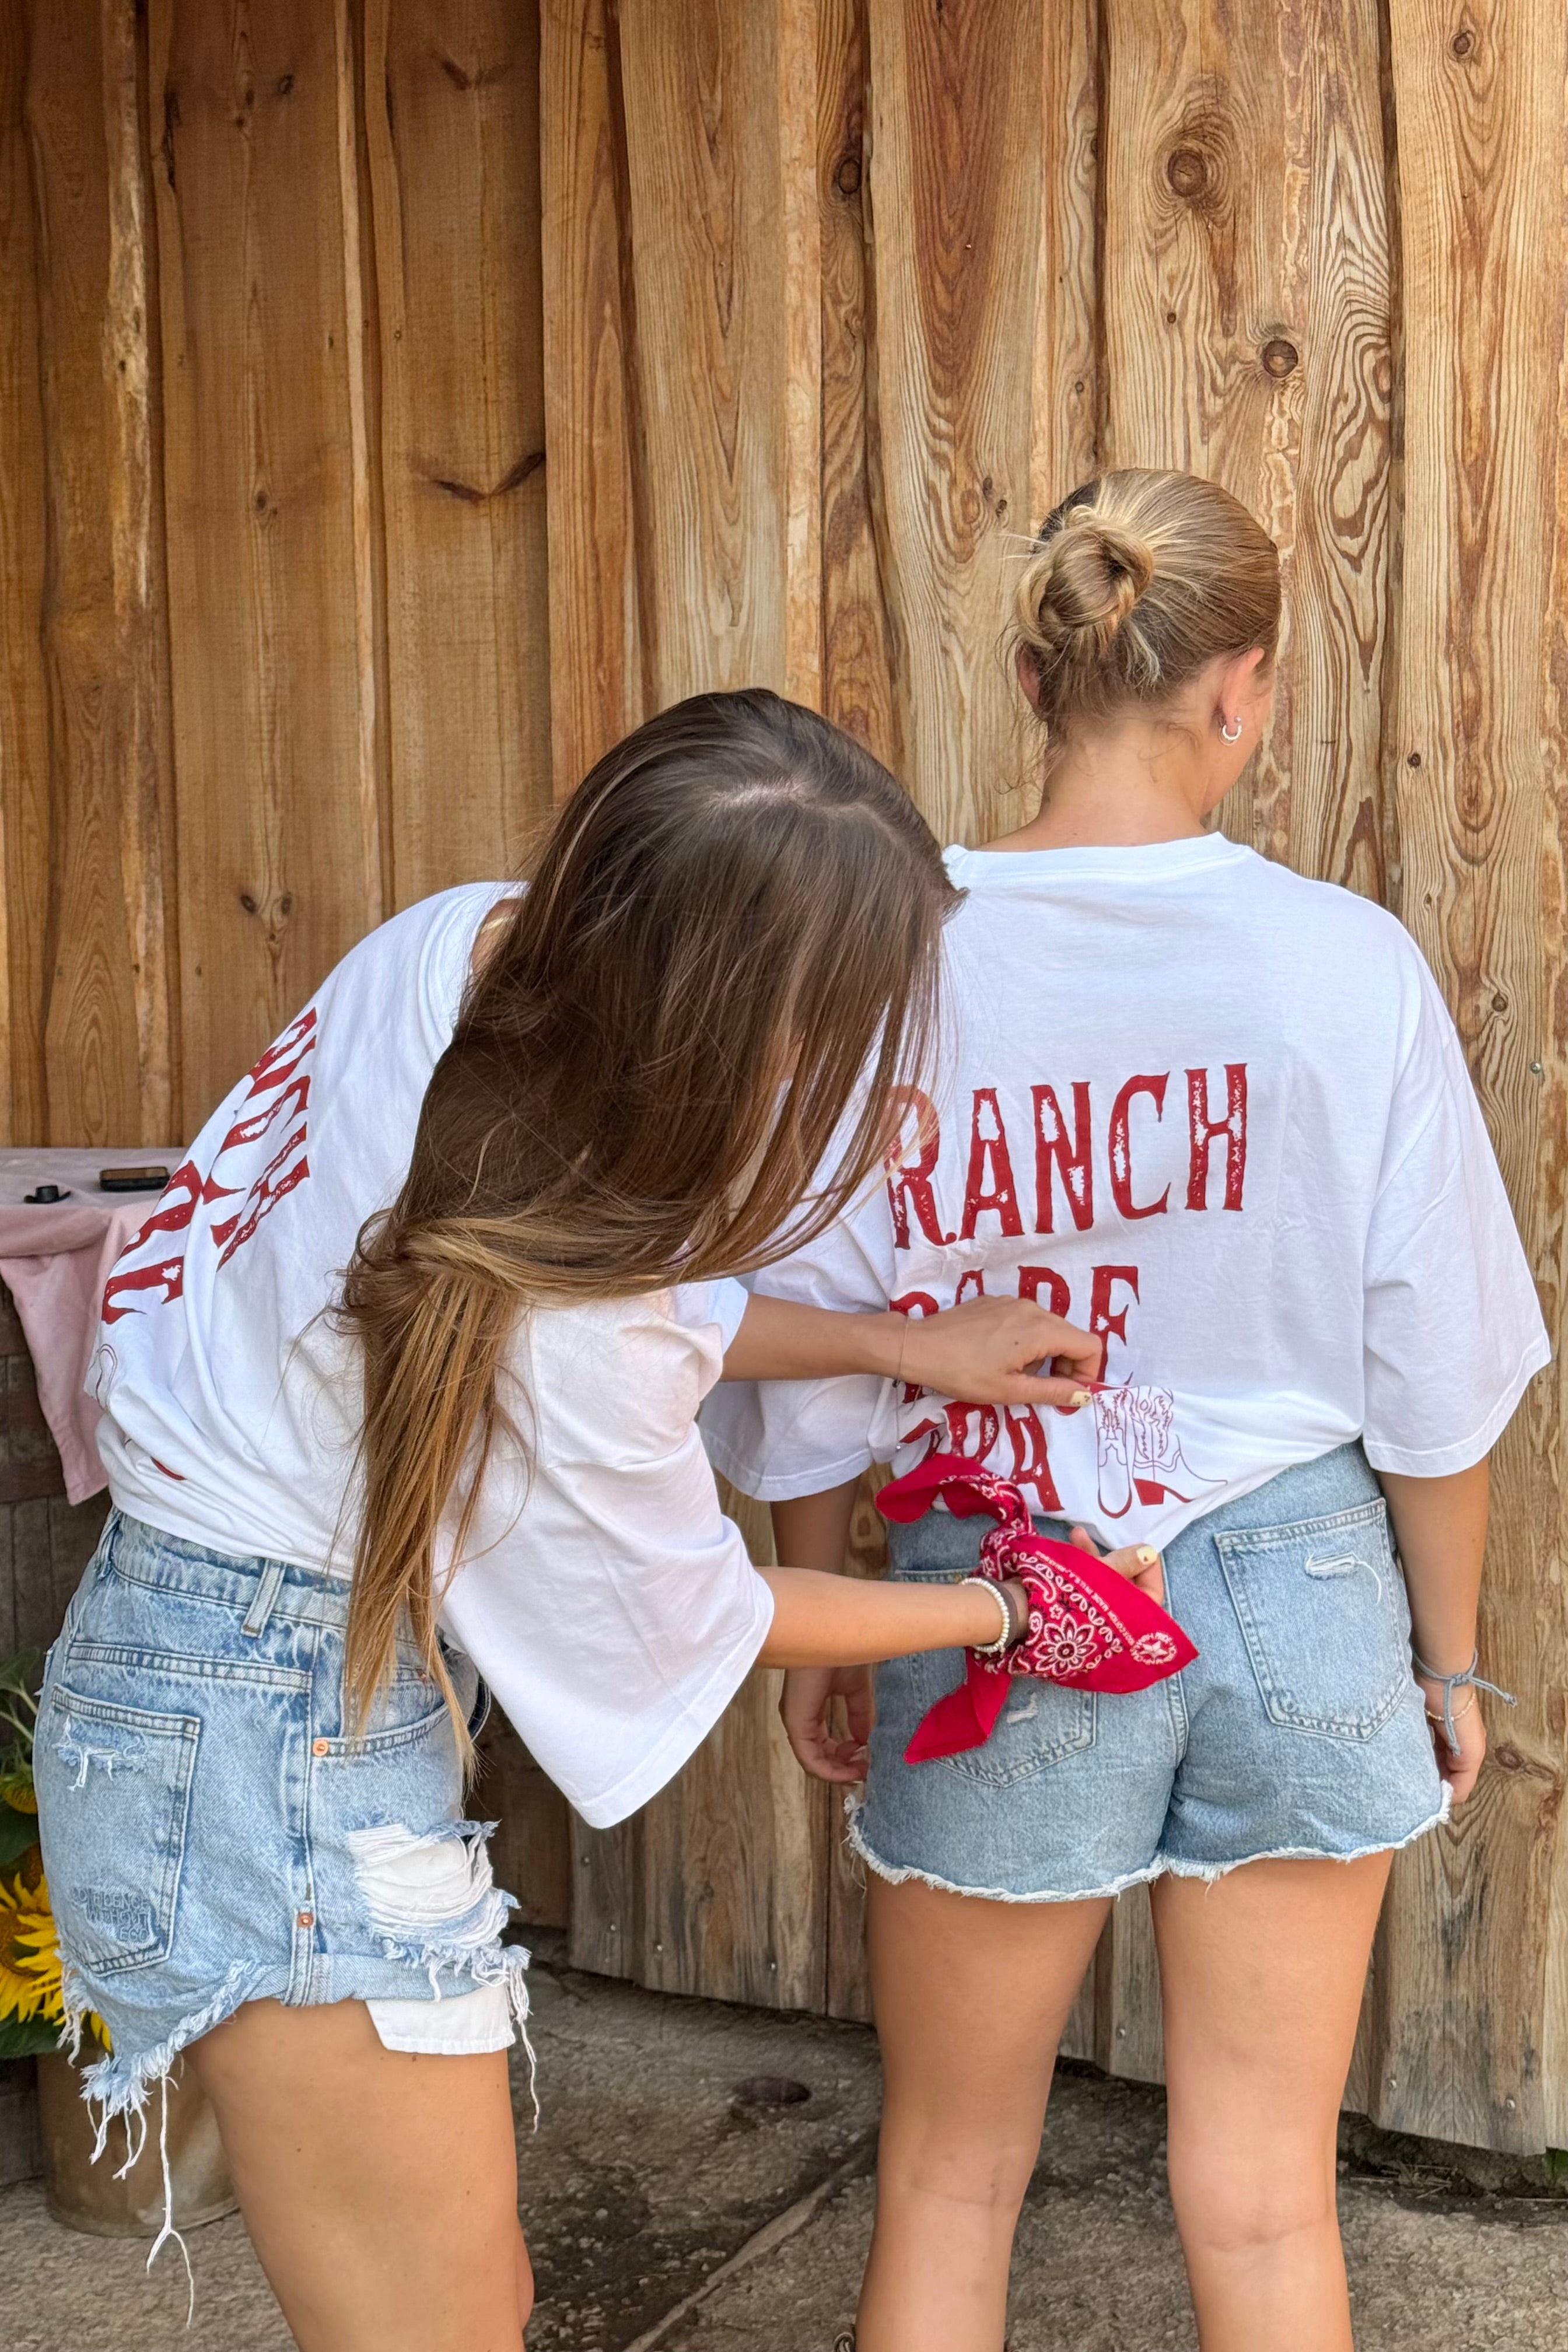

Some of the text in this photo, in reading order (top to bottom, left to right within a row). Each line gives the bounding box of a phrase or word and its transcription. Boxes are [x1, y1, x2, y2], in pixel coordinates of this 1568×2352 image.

[884, 1063, 1248, 1250] RANCH
[87, 1907, 148, 1925] WITHOUT
[119, 1926, 149, 1941] EGO
